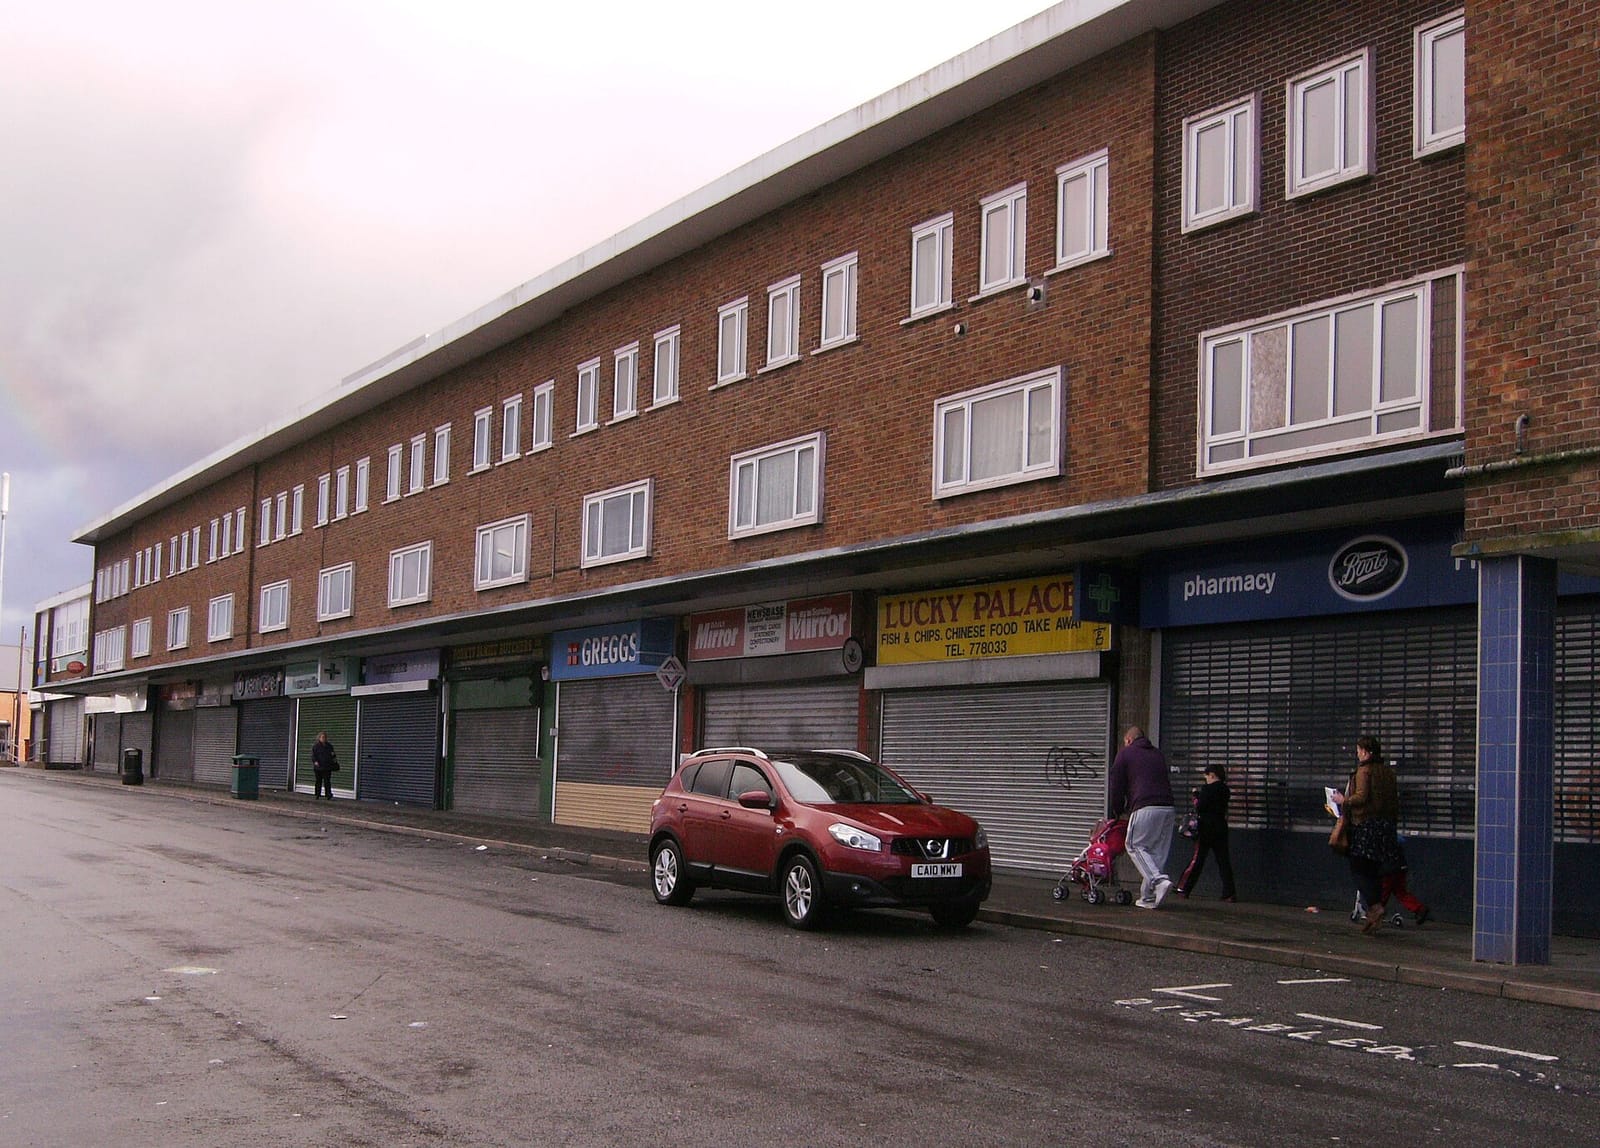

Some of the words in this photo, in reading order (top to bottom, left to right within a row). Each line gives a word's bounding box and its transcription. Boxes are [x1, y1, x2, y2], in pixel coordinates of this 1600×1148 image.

[1338, 549, 1388, 586] Boots
[1184, 572, 1276, 600] pharmacy
[789, 612, 847, 641] Mirror
[885, 596, 964, 629] LUCKY
[695, 623, 738, 649] Mirror
[881, 632, 900, 645] FISH
[903, 631, 910, 644] &
[945, 624, 986, 641] CHINESE
[990, 621, 1018, 636] FOOD
[1024, 618, 1050, 634] TAKE
[582, 633, 637, 666] GREGGS
[944, 643, 965, 657] TEL:
[969, 640, 1007, 655] 778033
